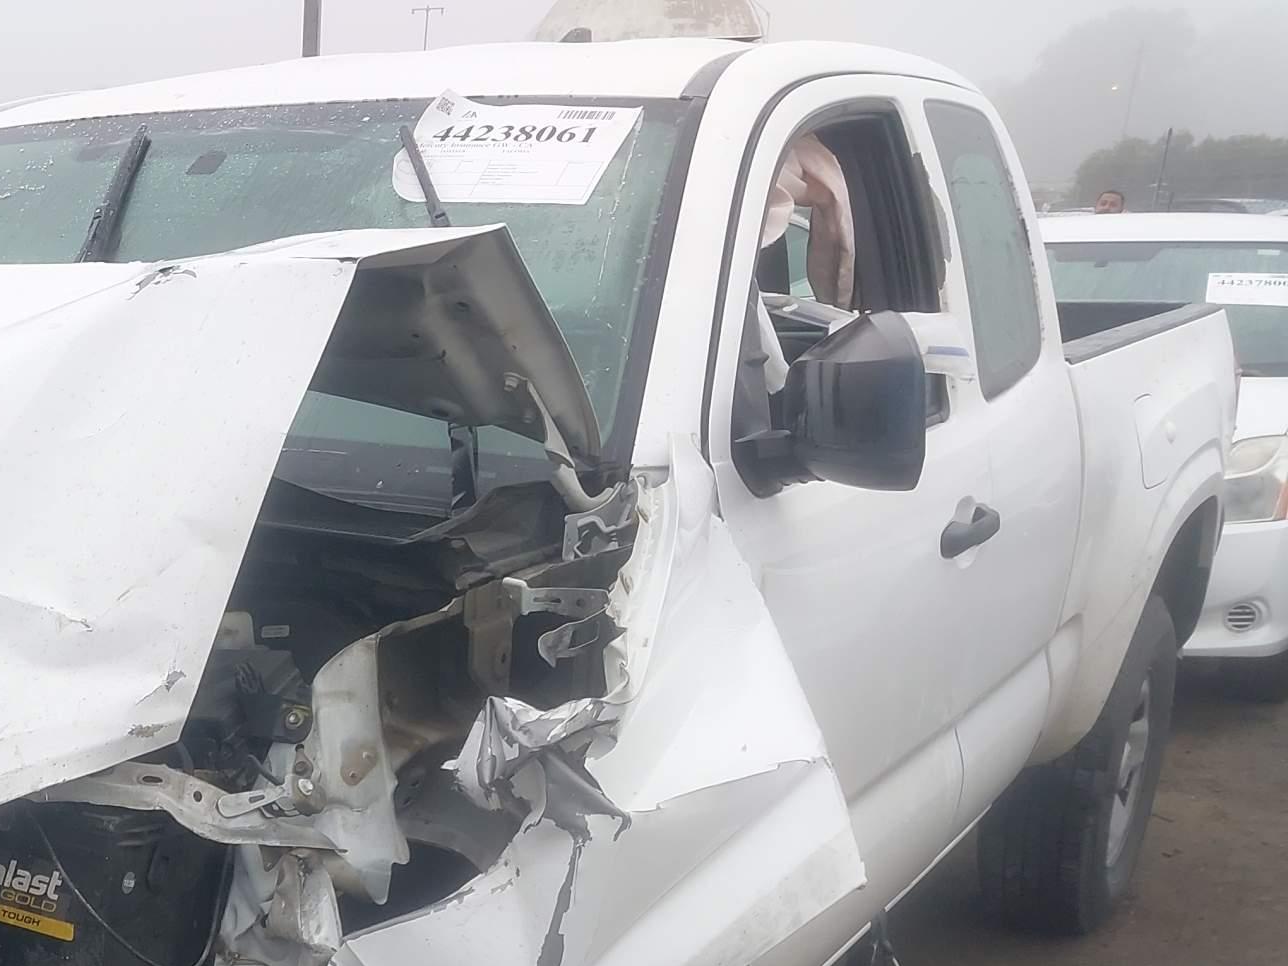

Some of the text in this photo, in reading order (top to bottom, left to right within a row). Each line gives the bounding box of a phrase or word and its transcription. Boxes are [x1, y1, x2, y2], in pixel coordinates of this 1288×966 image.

[432, 124, 599, 144] 44238061
[0, 889, 57, 912] GOLD
[0, 909, 41, 927] TOUGH
